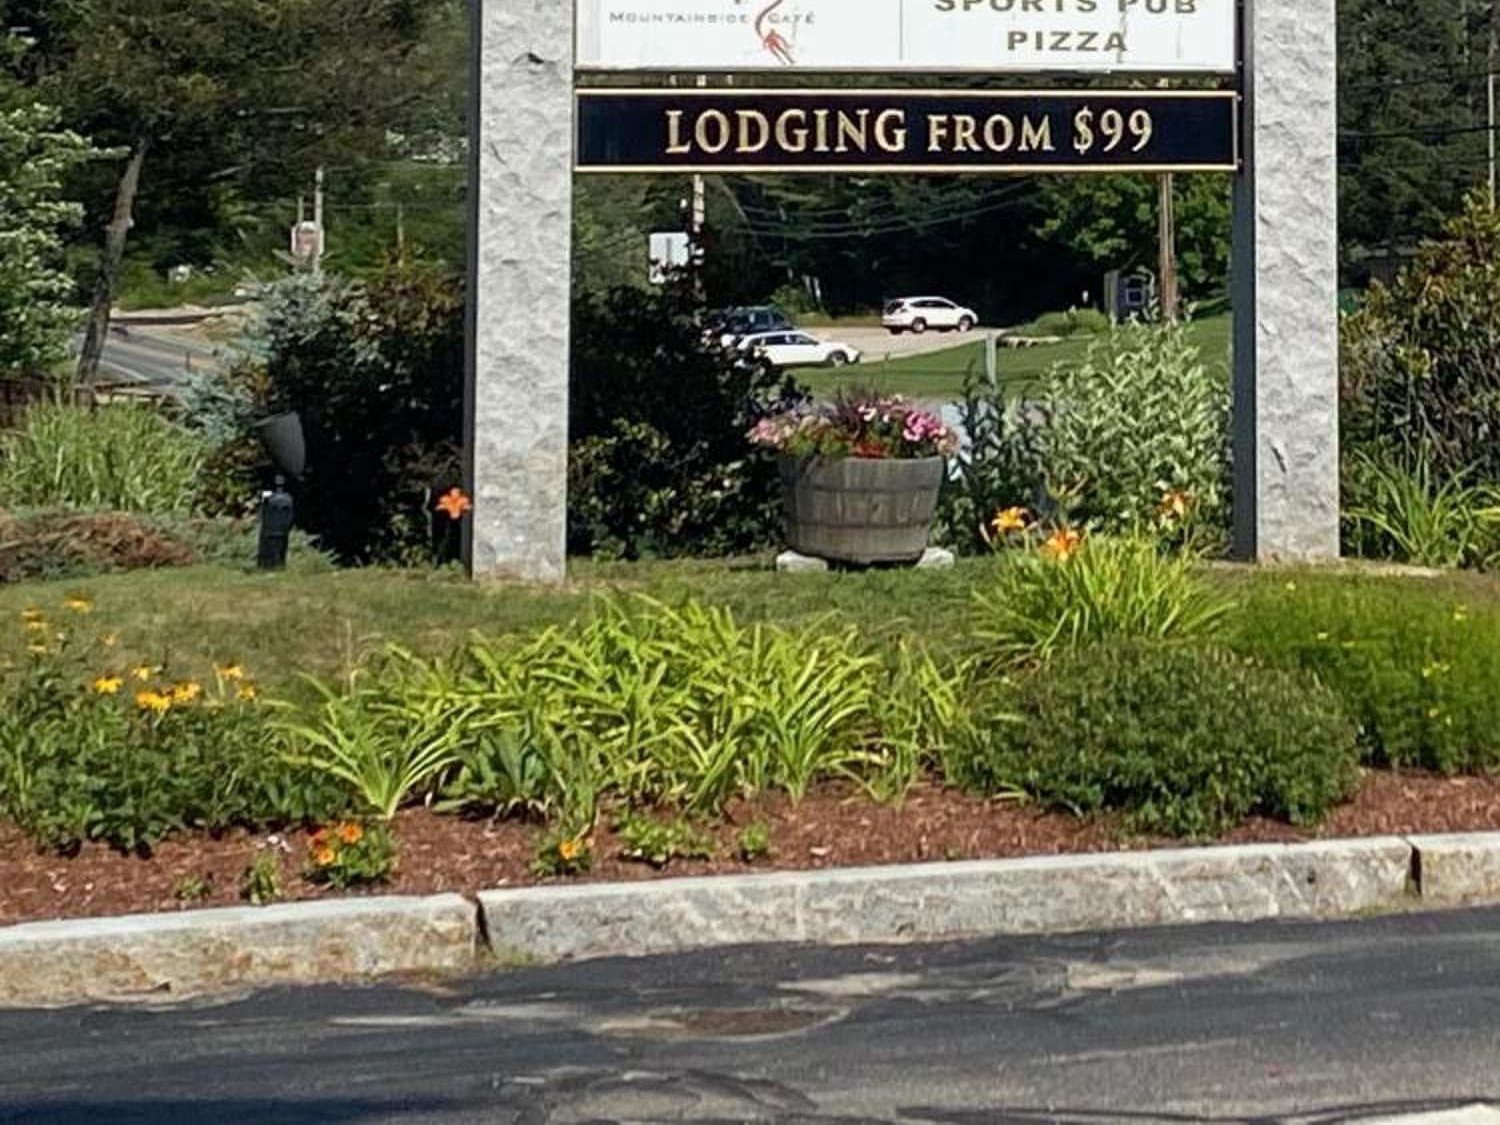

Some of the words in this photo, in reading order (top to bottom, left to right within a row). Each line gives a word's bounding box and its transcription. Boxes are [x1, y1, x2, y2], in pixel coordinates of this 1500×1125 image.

[1007, 30, 1128, 52] PIZZA
[664, 108, 908, 154] LODGING
[927, 114, 1056, 152] FROM
[1073, 106, 1154, 154] $99
